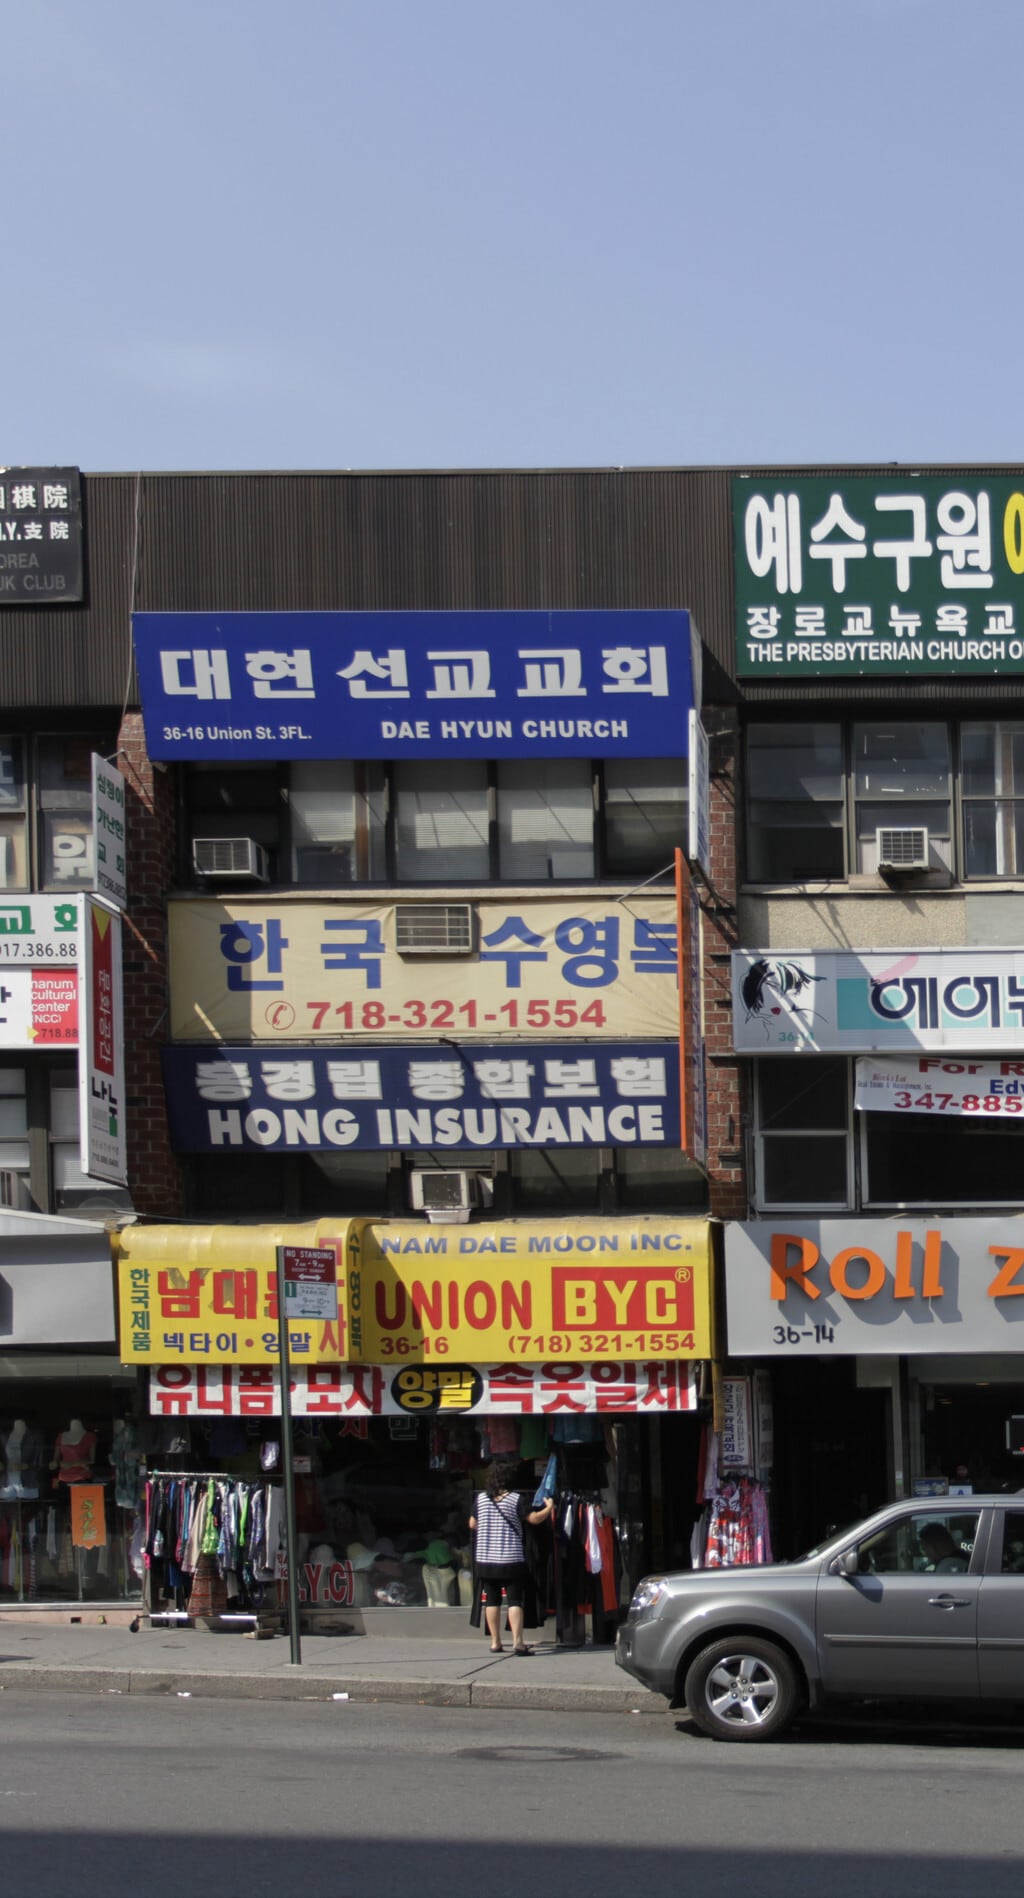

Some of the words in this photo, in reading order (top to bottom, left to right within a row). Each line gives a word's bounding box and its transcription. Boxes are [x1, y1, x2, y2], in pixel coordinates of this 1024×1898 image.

[0, 485, 69, 509] 棋院
[0, 522, 21, 540] .Y.
[744, 491, 994, 593] 예수구원
[23, 575, 66, 590] CLUB
[747, 641, 783, 662] THE
[786, 640, 924, 662] PRESBYTERIAN
[927, 640, 1005, 661] CHURCH
[163, 727, 204, 740] 36-16
[206, 726, 251, 740] Union
[256, 725, 276, 739] St.
[279, 725, 312, 739] 3FL.
[382, 721, 431, 739] DAE
[440, 720, 513, 739] HYUN
[522, 719, 629, 738] CHURCH
[0, 943, 78, 957] 17.386.88
[219, 918, 386, 992] 한국
[31, 989, 76, 1000] cultural
[32, 979, 74, 989] nanum
[31, 1001, 70, 1012] center
[306, 999, 607, 1030] 718-321-1554
[31, 1014, 62, 1024] (NCC)
[919, 1058, 984, 1075] For
[408, 1056, 668, 1100] 종합보험
[207, 1108, 361, 1145] HONG
[375, 1104, 666, 1145] INSURANCE
[381, 1236, 448, 1254] NAM
[459, 1236, 518, 1253] DAE
[528, 1235, 619, 1253] MOON
[630, 1233, 692, 1251] INC.
[286, 1249, 296, 1257] NO
[300, 1250, 333, 1260] STANDING
[769, 1230, 944, 1303] Roll
[129, 1268, 152, 1352] 한국제품
[375, 1279, 532, 1331] UNION
[564, 1280, 678, 1325] BYC
[380, 1336, 449, 1355] 36-16
[508, 1335, 572, 1354] (718)
[579, 1333, 696, 1352] 321-1554
[773, 1325, 835, 1345] 36-14
[156, 1363, 275, 1415] 유니폼
[306, 1364, 386, 1415] 모자
[397, 1371, 476, 1409] 양말
